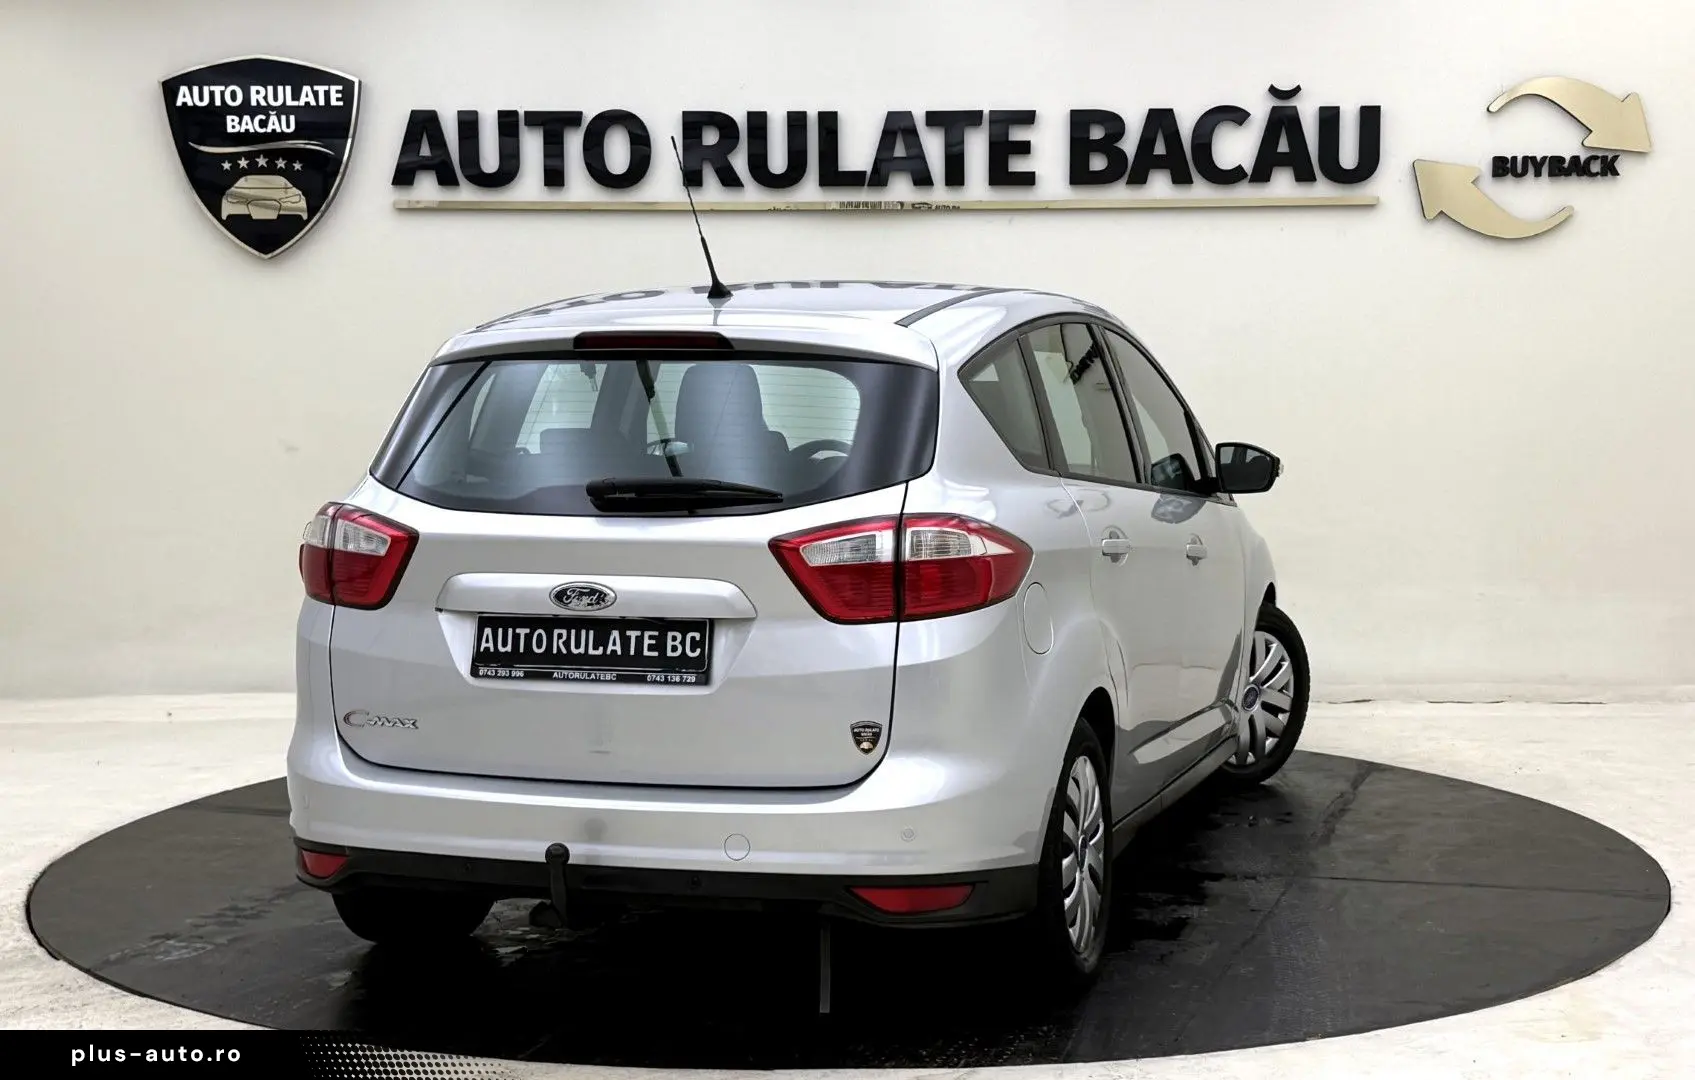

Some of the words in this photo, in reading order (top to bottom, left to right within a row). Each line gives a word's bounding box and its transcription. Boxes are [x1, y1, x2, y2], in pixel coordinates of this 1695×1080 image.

[175, 85, 243, 107] AUTO
[250, 85, 344, 107] RULATE
[226, 111, 296, 133] BACĂU
[391, 109, 652, 190] AUTO
[682, 109, 1036, 190] RULATE
[1069, 84, 1382, 186] BACĂU
[1491, 154, 1620, 178] BUYBACK
[480, 627, 547, 654] AUTO
[553, 628, 659, 657] RULATE
[666, 631, 702, 658] BC
[479, 669, 495, 677] 0743
[647, 674, 665, 682] 0743
